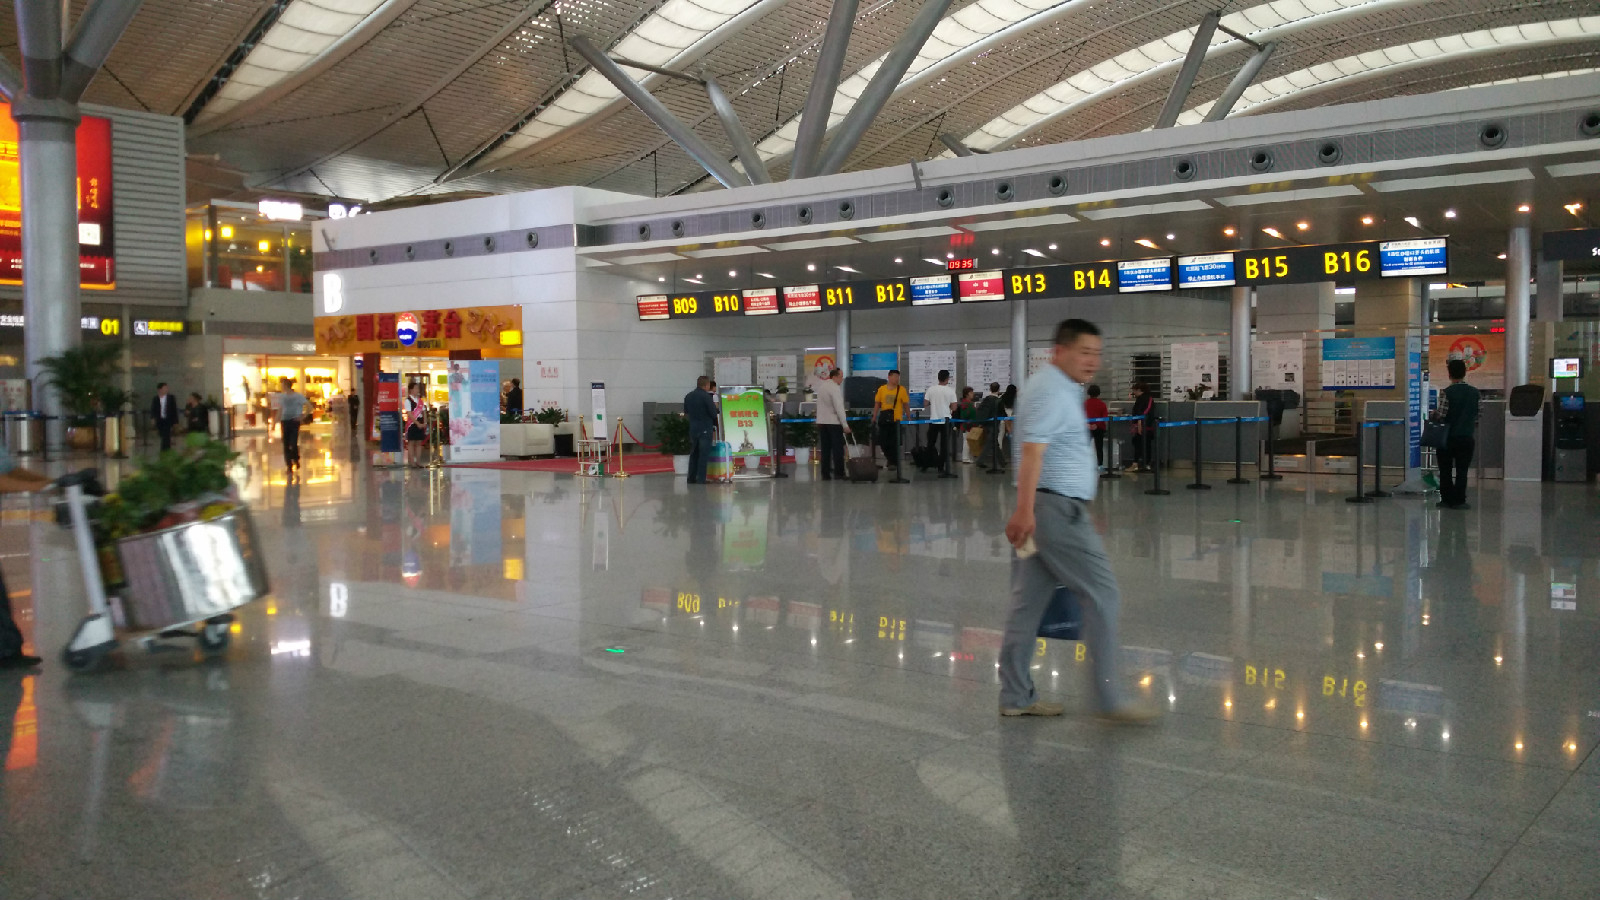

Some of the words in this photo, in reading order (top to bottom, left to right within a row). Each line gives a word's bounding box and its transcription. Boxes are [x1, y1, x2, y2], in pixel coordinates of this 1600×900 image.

[1245, 256, 1289, 279] B15
[1324, 250, 1371, 275] B16
[1011, 274, 1046, 294] B13
[1074, 269, 1111, 290] B14
[323, 273, 343, 313] B
[826, 287, 853, 305] B11
[876, 283, 906, 303] B12
[673, 297, 698, 314] B09
[714, 295, 739, 312] B10
[101, 318, 120, 336] 01
[737, 419, 753, 427] B13
